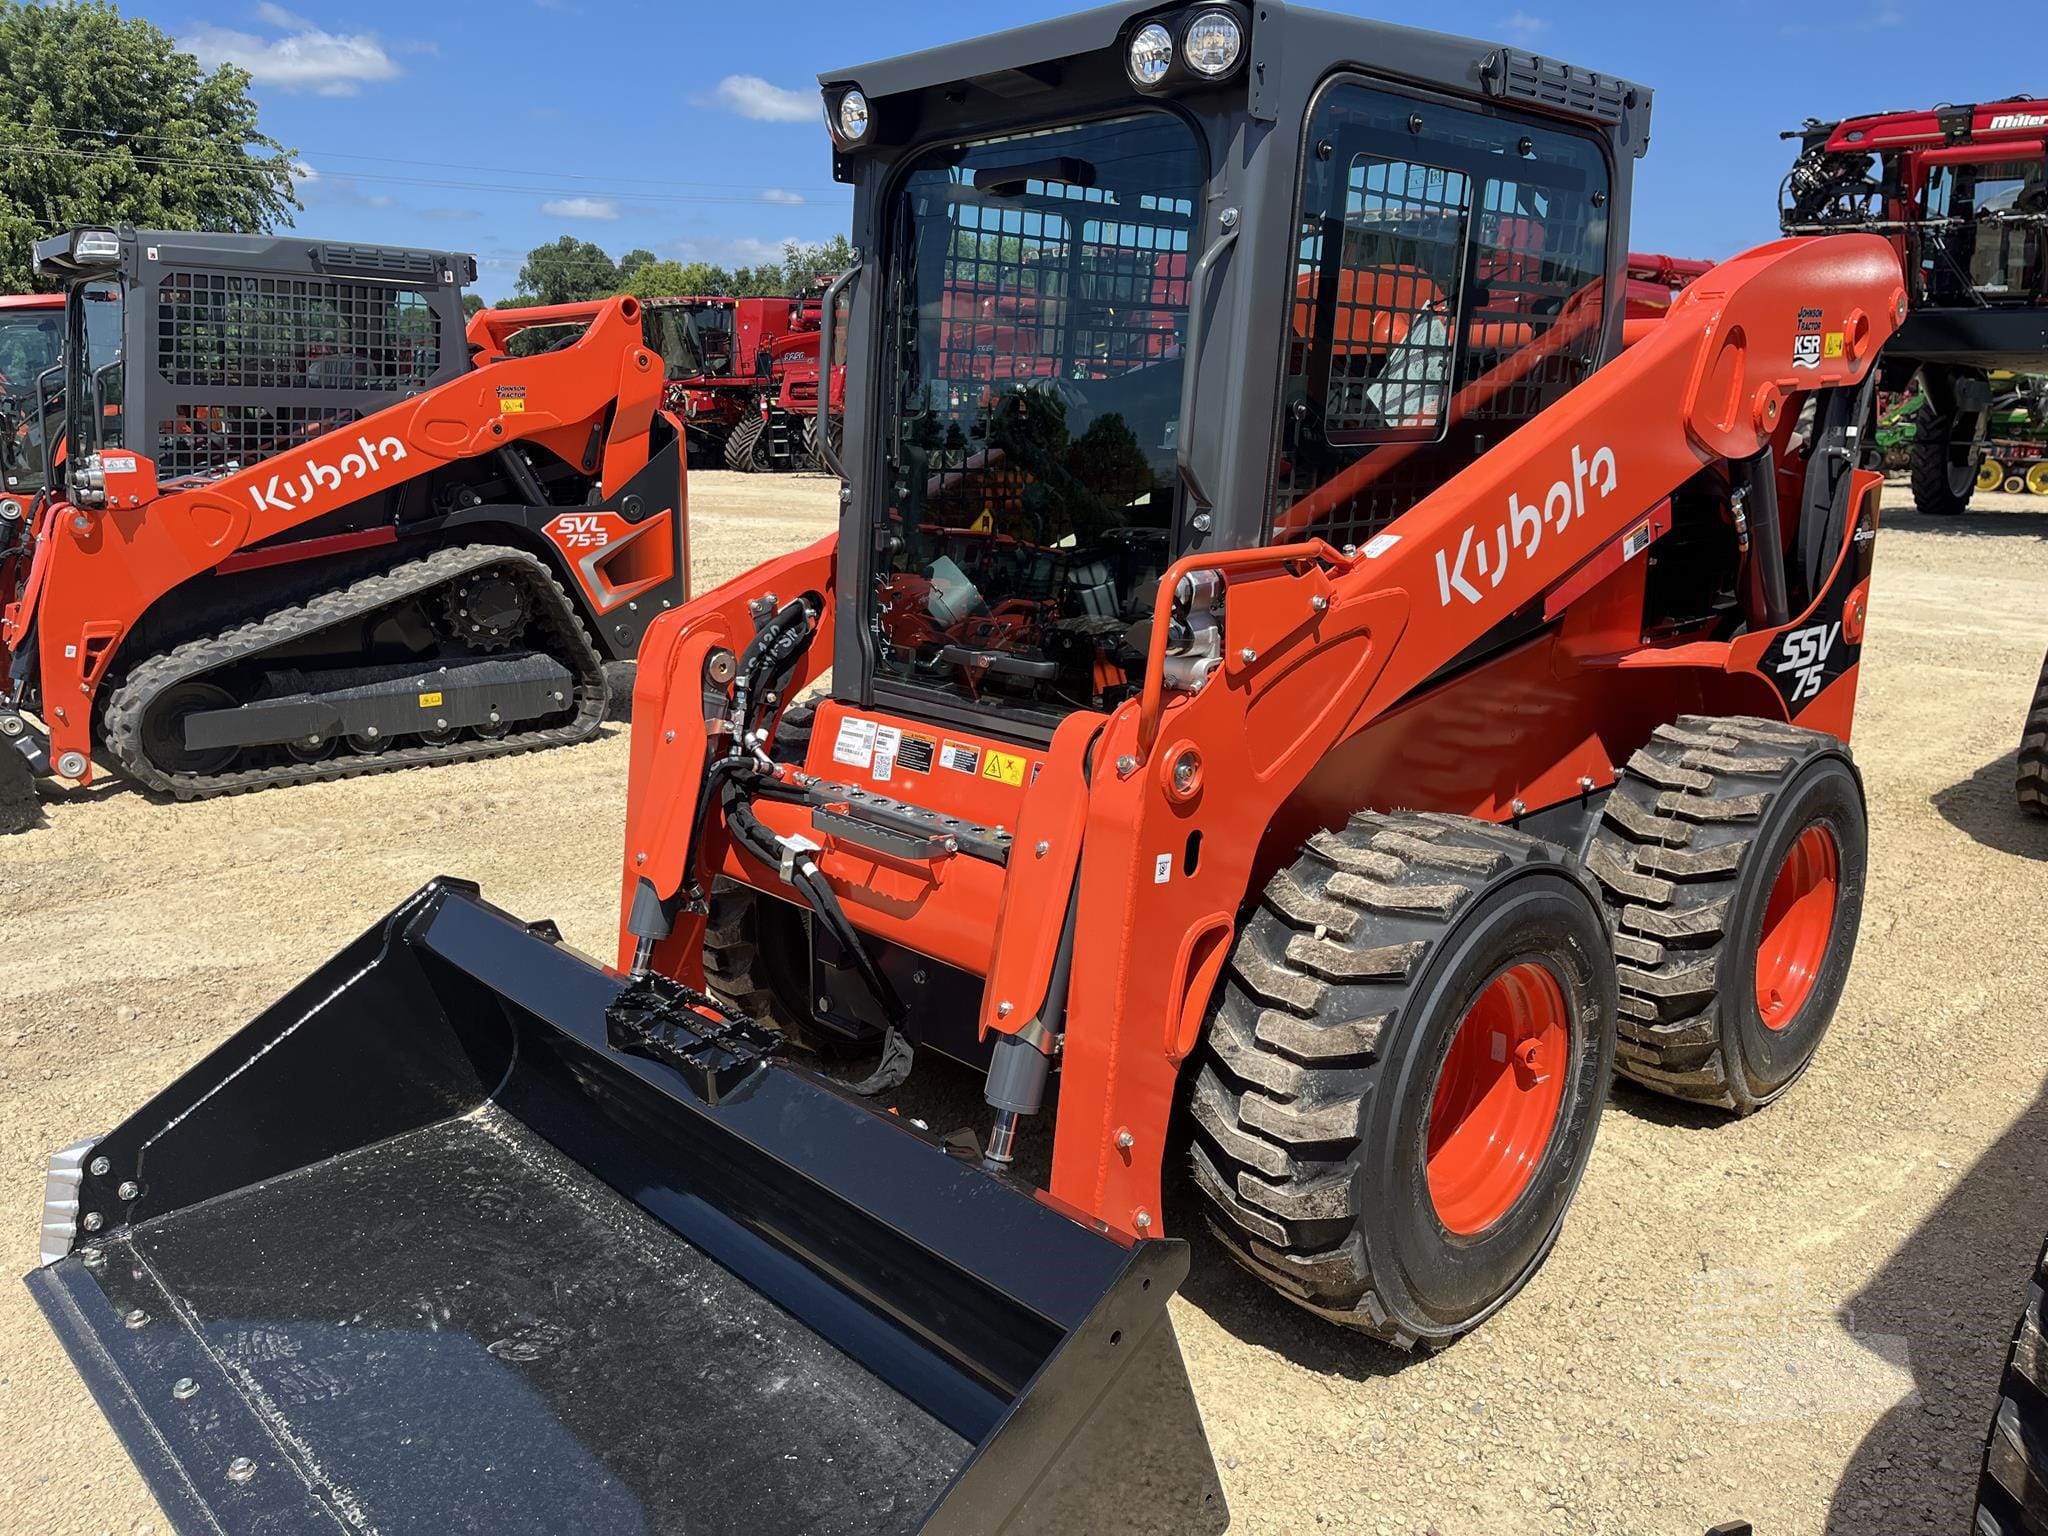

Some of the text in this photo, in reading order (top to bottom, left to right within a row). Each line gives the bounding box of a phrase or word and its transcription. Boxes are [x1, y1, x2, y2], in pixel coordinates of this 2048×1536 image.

[1794, 335, 1821, 354] KSR
[248, 436, 408, 512] Kubota
[556, 516, 606, 534] SVL
[566, 533, 608, 548] 75-3
[1435, 444, 1617, 607] Kubota
[1776, 621, 1841, 673] SSV
[1790, 663, 1825, 702] 75
